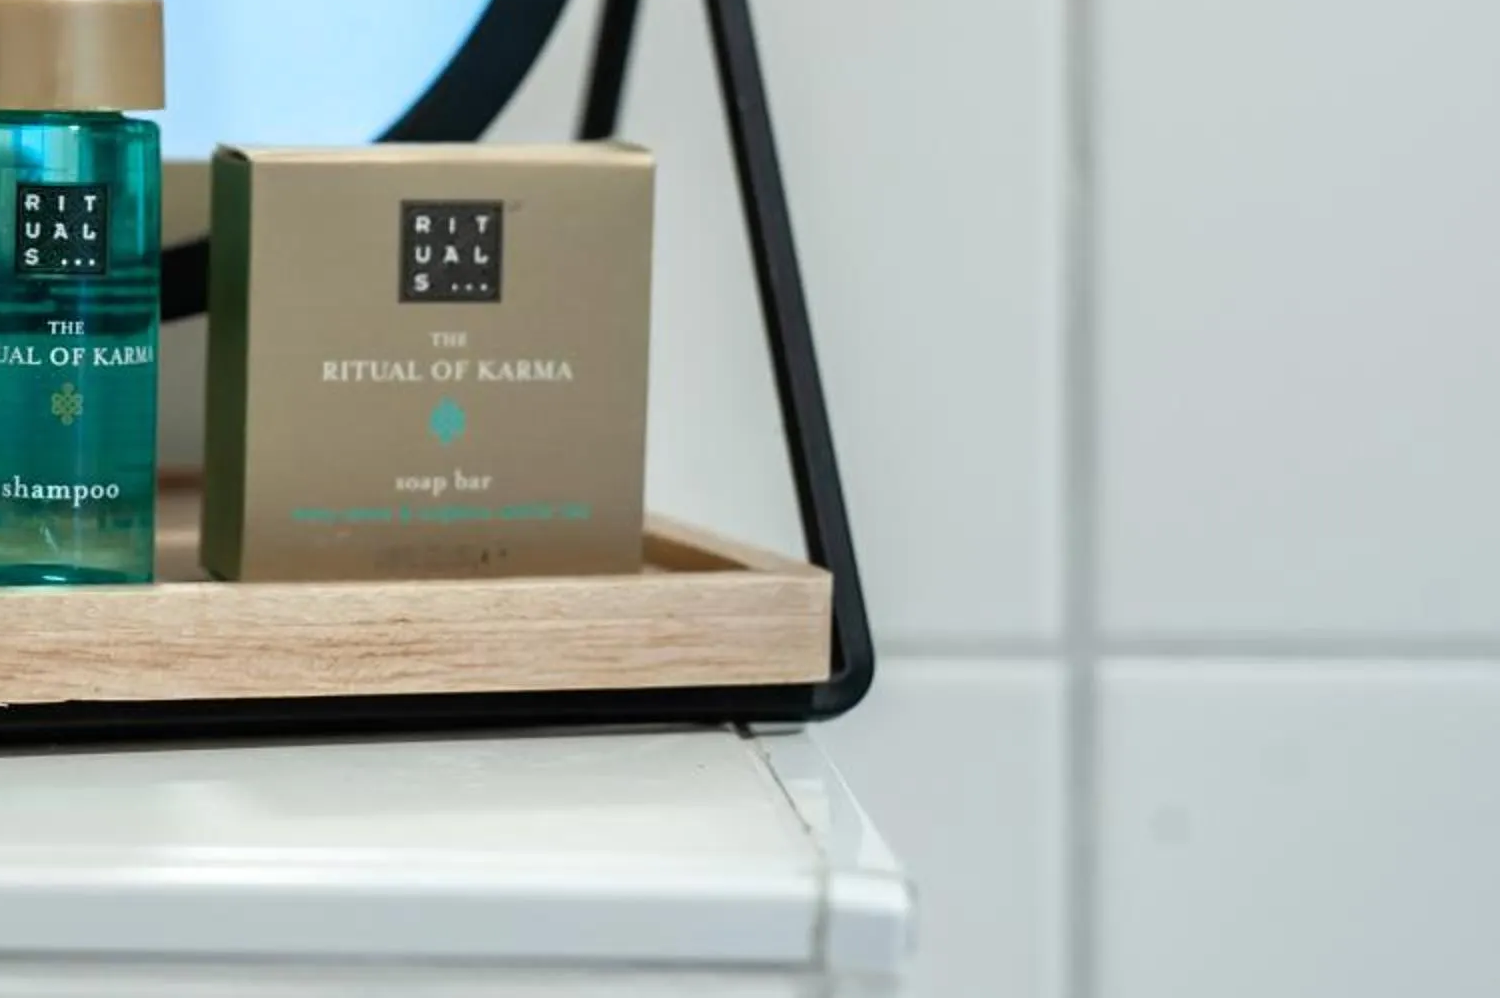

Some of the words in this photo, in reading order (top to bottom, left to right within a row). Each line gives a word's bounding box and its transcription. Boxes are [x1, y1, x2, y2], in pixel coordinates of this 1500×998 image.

[47, 320, 85, 335] THE
[429, 331, 467, 347] THE
[50, 346, 86, 366] OF
[322, 360, 423, 382] RITUAL
[430, 360, 469, 382] OF
[477, 359, 574, 382] KARMA
[2, 474, 120, 508] shampoo
[395, 475, 447, 497] soap
[454, 468, 493, 491] bar
